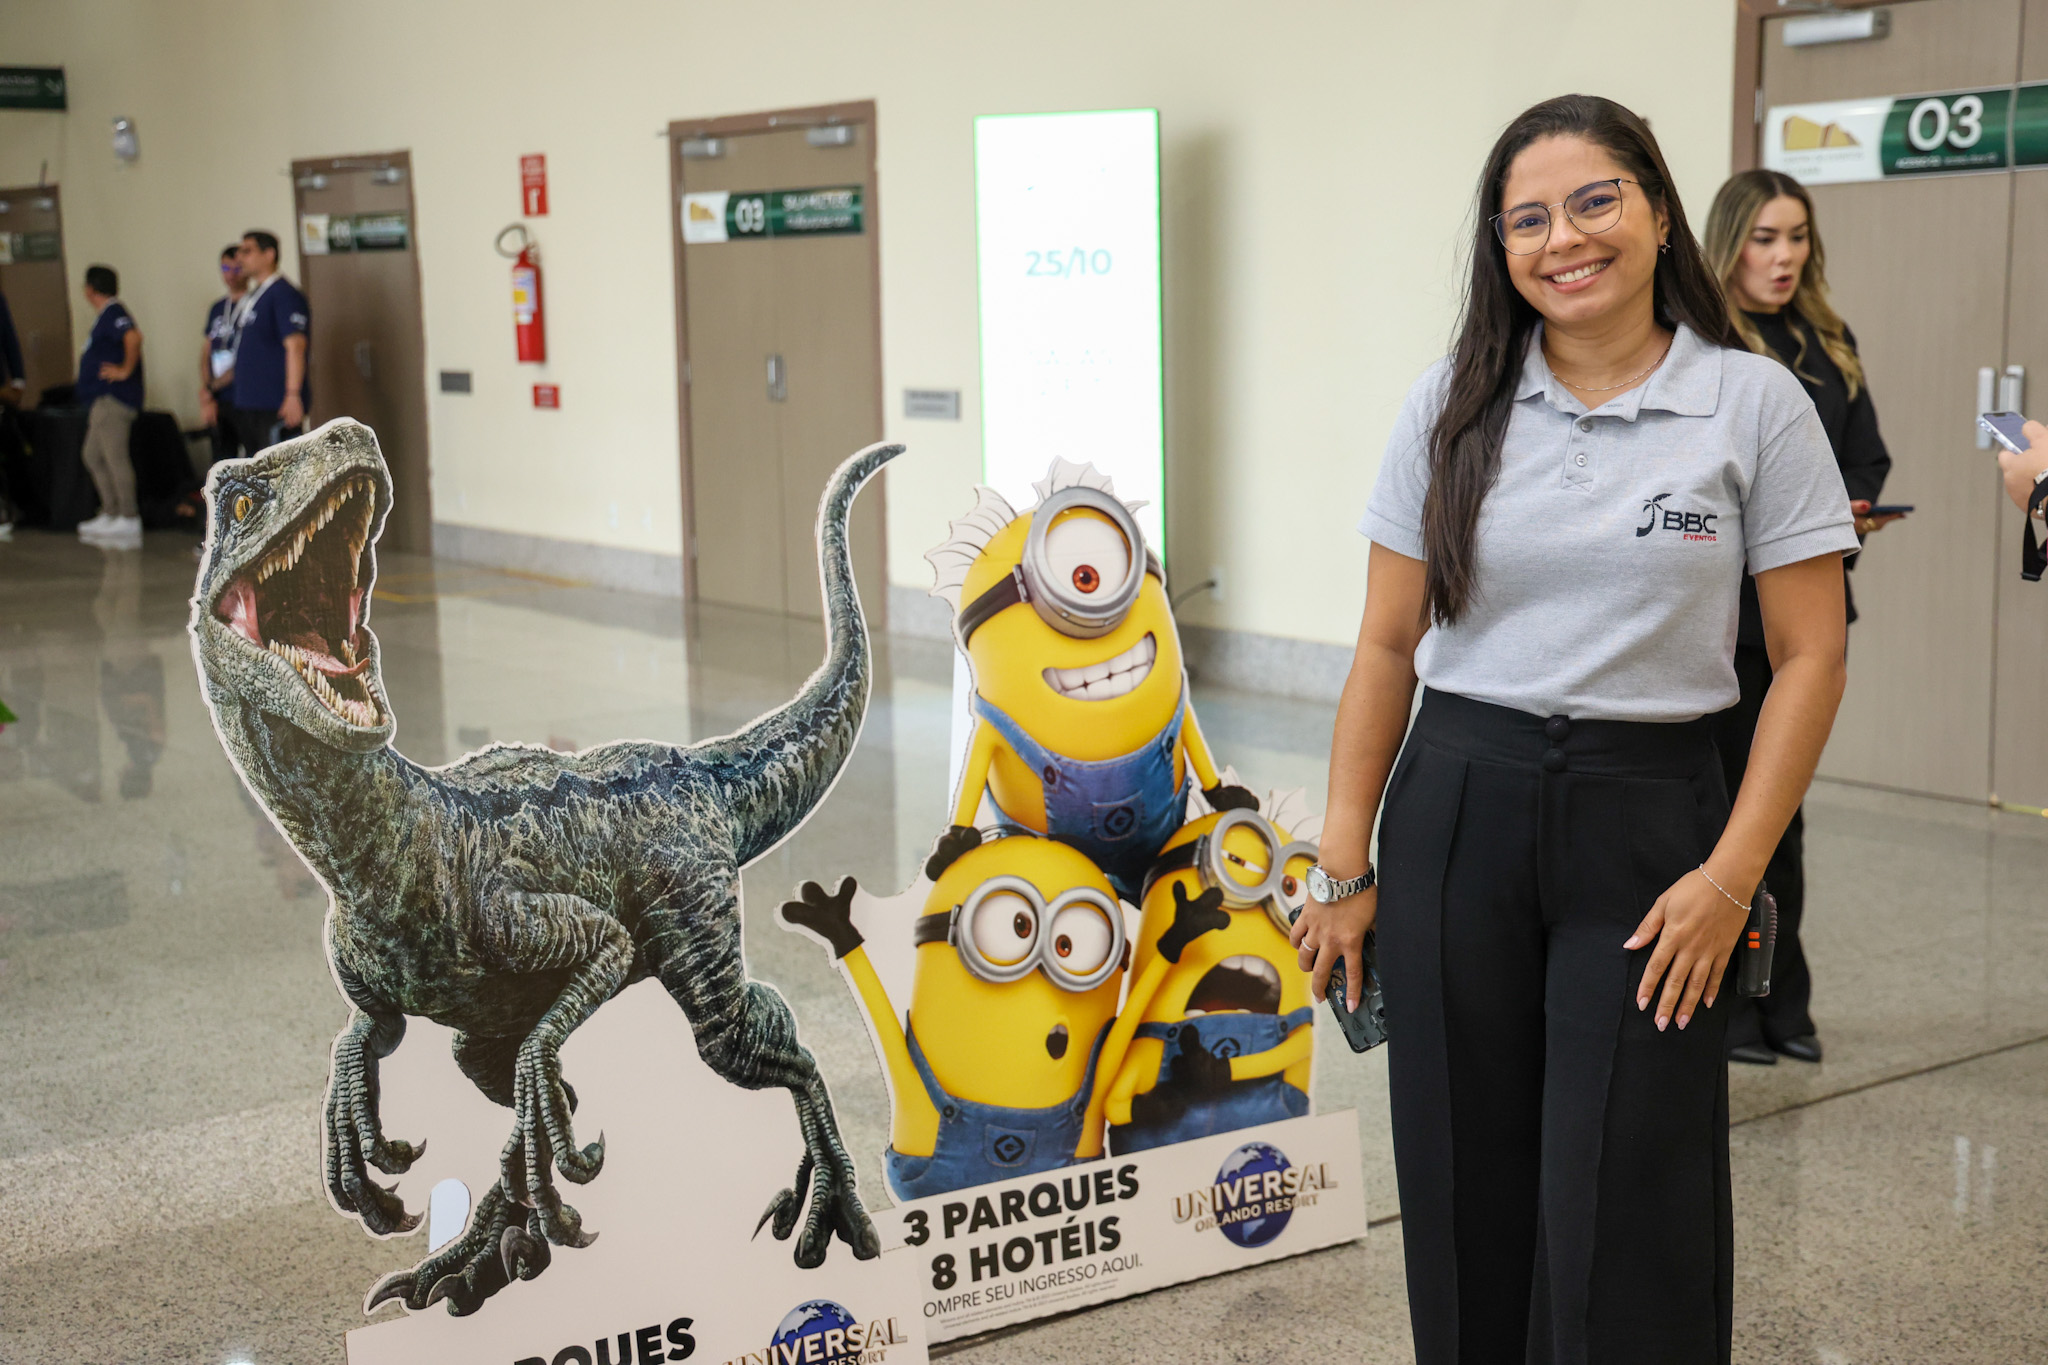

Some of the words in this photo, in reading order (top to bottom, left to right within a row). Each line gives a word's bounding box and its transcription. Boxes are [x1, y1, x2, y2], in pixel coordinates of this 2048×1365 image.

[1908, 95, 1984, 151] 03
[735, 198, 765, 233] 03
[1025, 246, 1112, 279] 25/10
[1662, 510, 1718, 534] BBC
[1683, 533, 1717, 542] EVENTOS
[903, 1209, 930, 1247] 3
[943, 1164, 1139, 1239] PARQUES
[1171, 1162, 1339, 1224] UNIVERSAL
[1195, 1204, 1262, 1233] ORLANDO
[1265, 1193, 1319, 1214] RESORT
[931, 1253, 957, 1291] 8
[969, 1215, 1121, 1282] HOTÉIS
[923, 1290, 982, 1317] OMPRE
[985, 1282, 1015, 1303] SEU
[1019, 1263, 1097, 1294] INGRESSO
[1100, 1253, 1143, 1276] AQUI.
